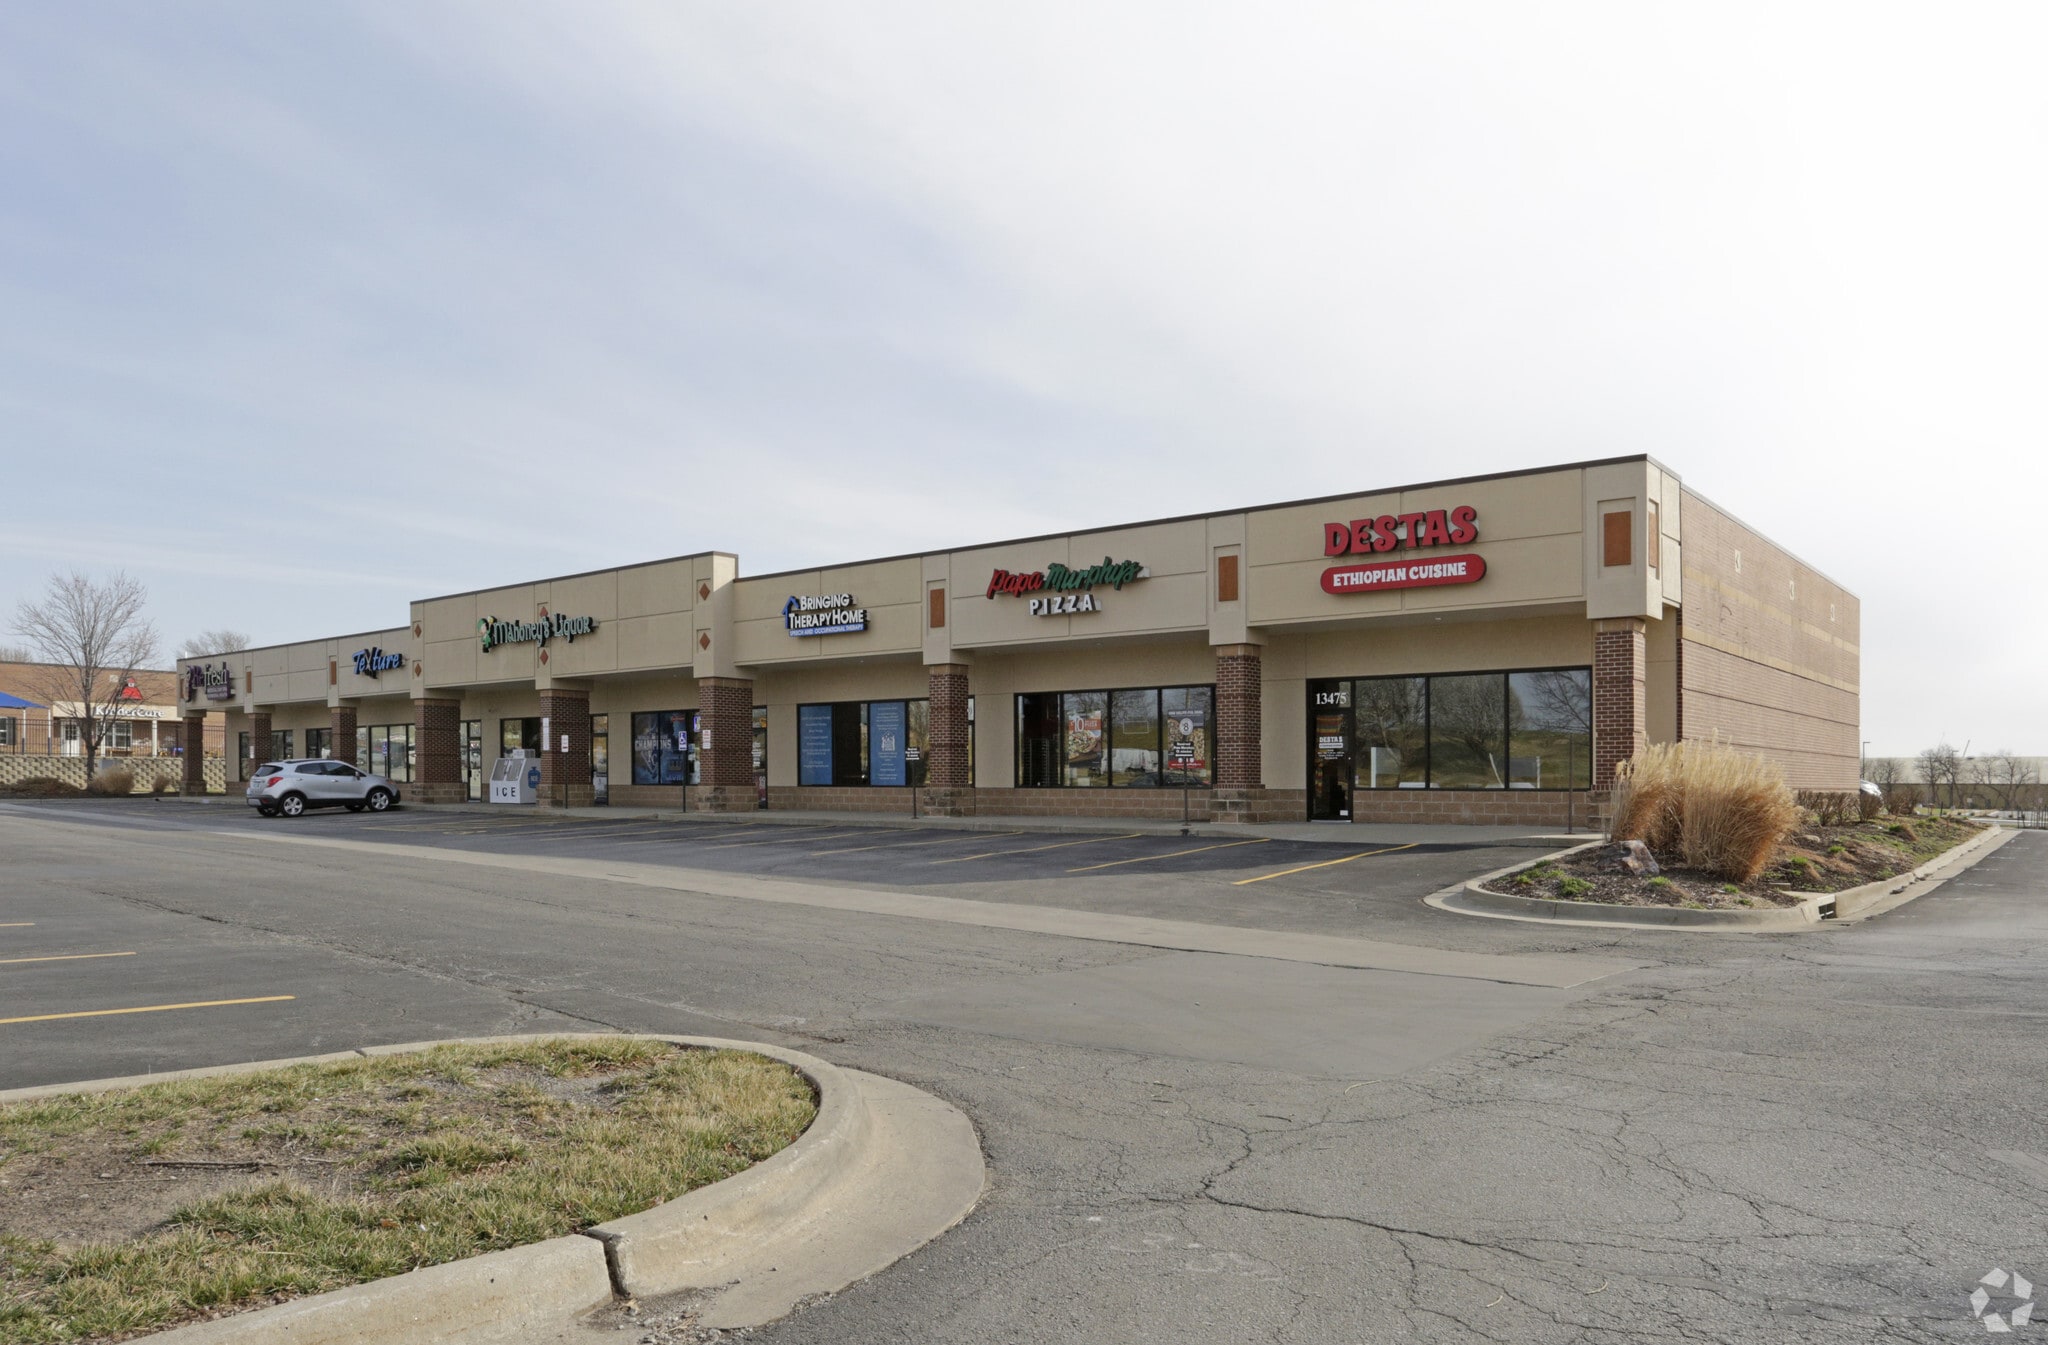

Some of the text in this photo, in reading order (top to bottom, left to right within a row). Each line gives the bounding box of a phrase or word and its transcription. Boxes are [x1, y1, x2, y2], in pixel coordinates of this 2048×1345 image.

[1324, 505, 1477, 556] DESTAS
[987, 569, 1044, 599] Papa
[1333, 562, 1466, 587] ETHIOPIAN CUISINE
[800, 593, 850, 611] BRINGING
[1030, 594, 1094, 615] PIZZA
[493, 616, 550, 648] Mahoney's
[1316, 692, 1347, 705] 13475
[496, 787, 516, 797] ICE
